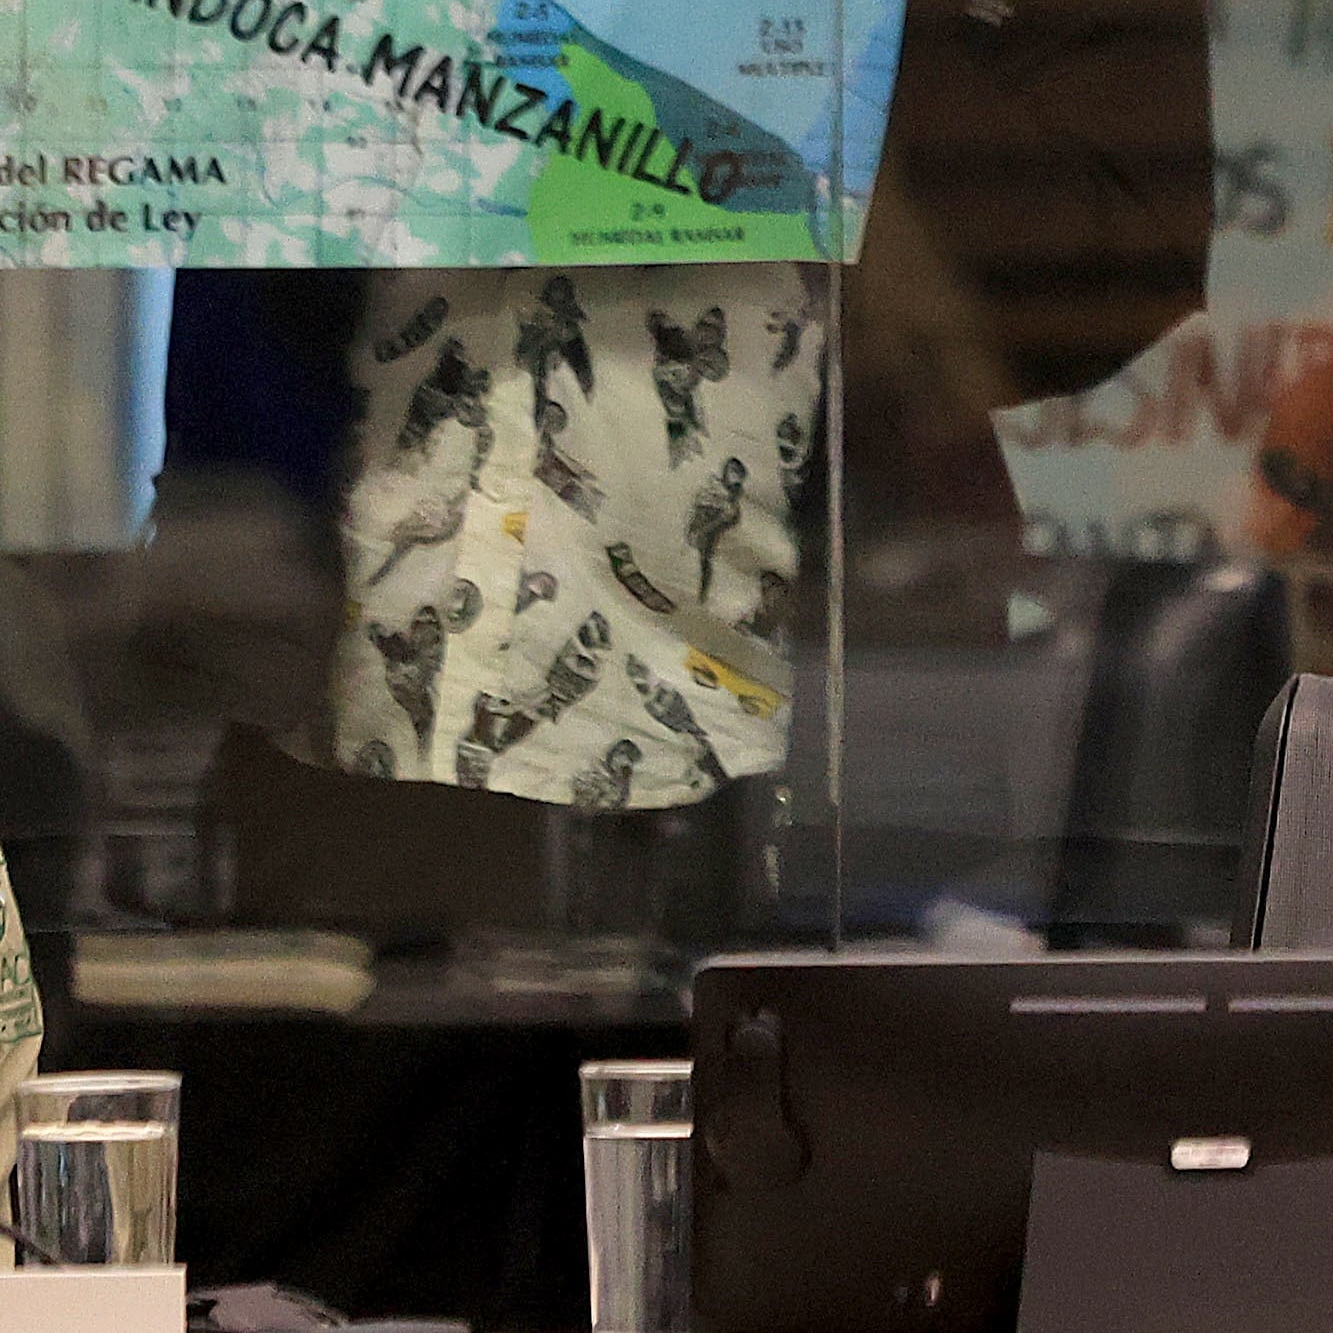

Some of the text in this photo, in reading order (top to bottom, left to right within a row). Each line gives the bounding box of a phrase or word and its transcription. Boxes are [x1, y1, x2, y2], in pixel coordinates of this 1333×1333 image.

[363, 33, 742, 206] MANZANILLO
[0, 155, 226, 186] del REGAMA
[86, 199, 129, 232] de
[143, 203, 202, 240] Ley
